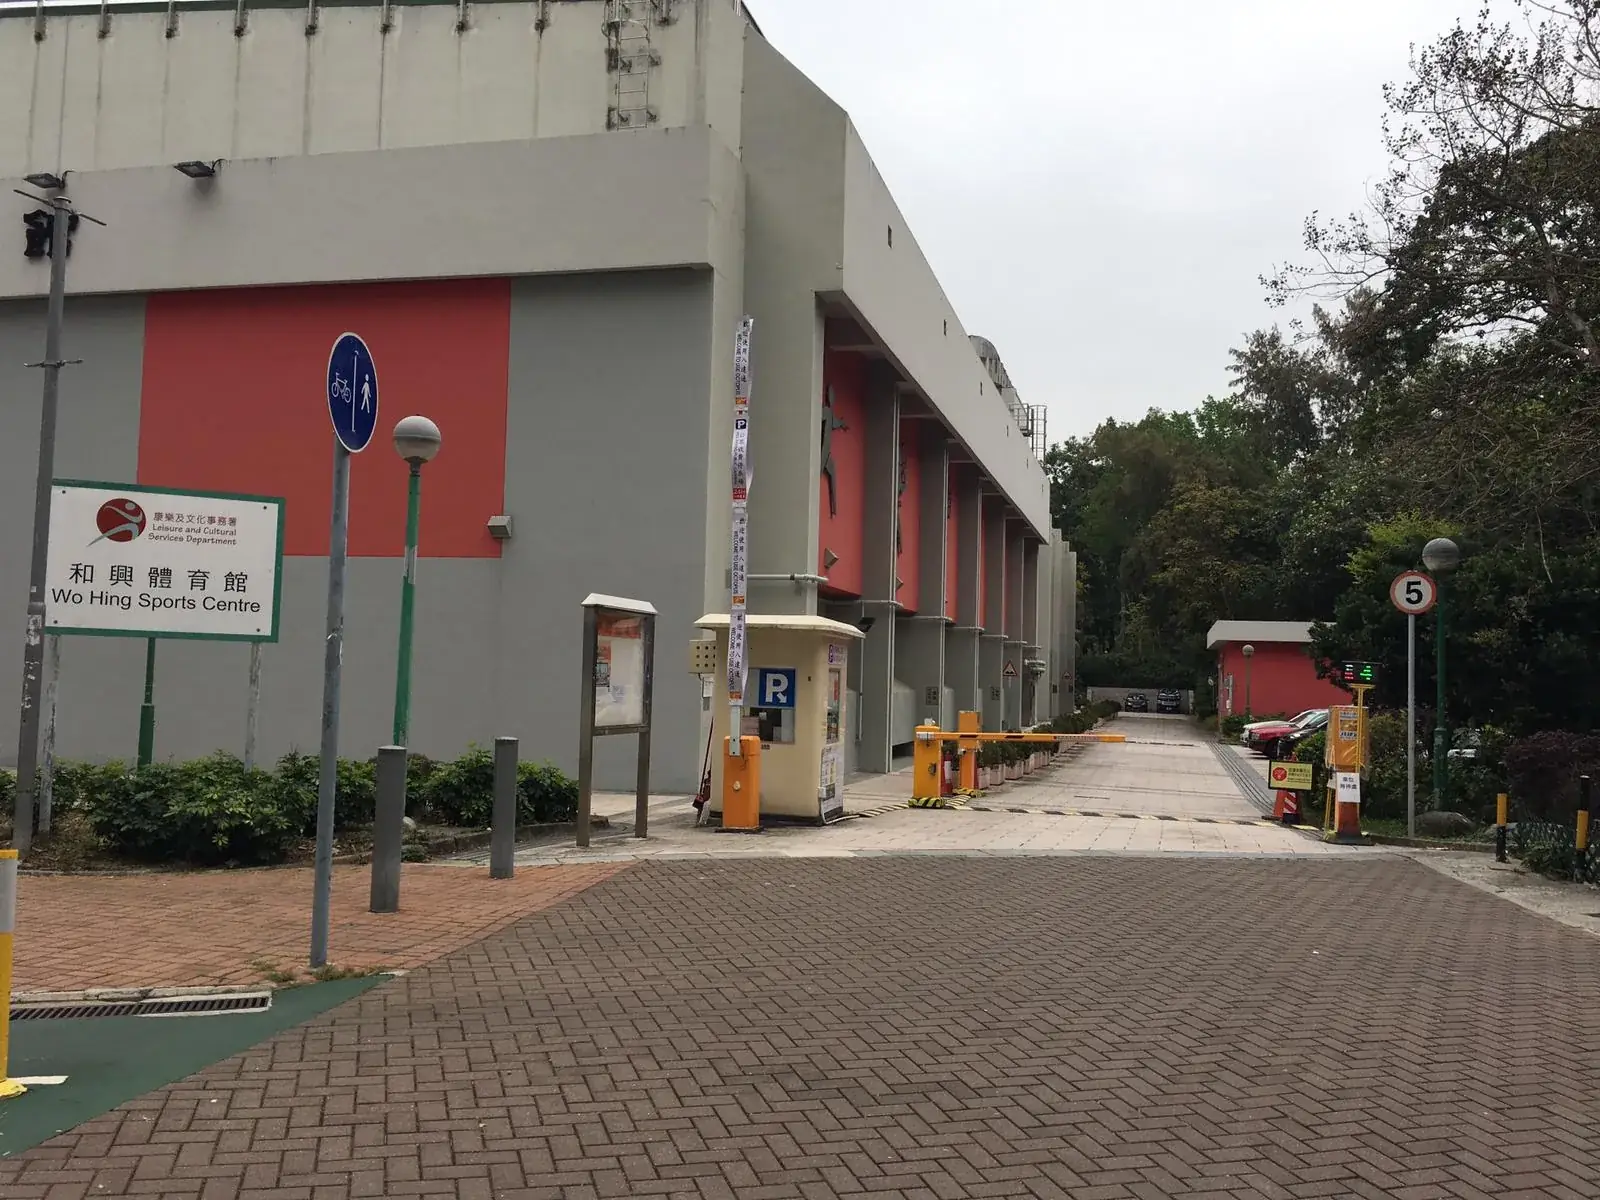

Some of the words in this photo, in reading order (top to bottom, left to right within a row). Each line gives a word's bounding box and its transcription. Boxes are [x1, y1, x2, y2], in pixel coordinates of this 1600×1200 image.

[152, 523, 184, 533] Leisure
[185, 526, 201, 534] and
[203, 526, 237, 536] Cultural
[153, 511, 237, 526] 康樂及文化事務署
[148, 532, 184, 542] Services
[186, 535, 237, 545] Department
[69, 562, 248, 593] 和興體育館
[52, 588, 83, 604] Wo
[90, 590, 132, 610] Hing
[138, 593, 196, 611] Sports
[203, 596, 261, 613] Centre
[1405, 580, 1423, 605] 5
[765, 673, 788, 703] P
